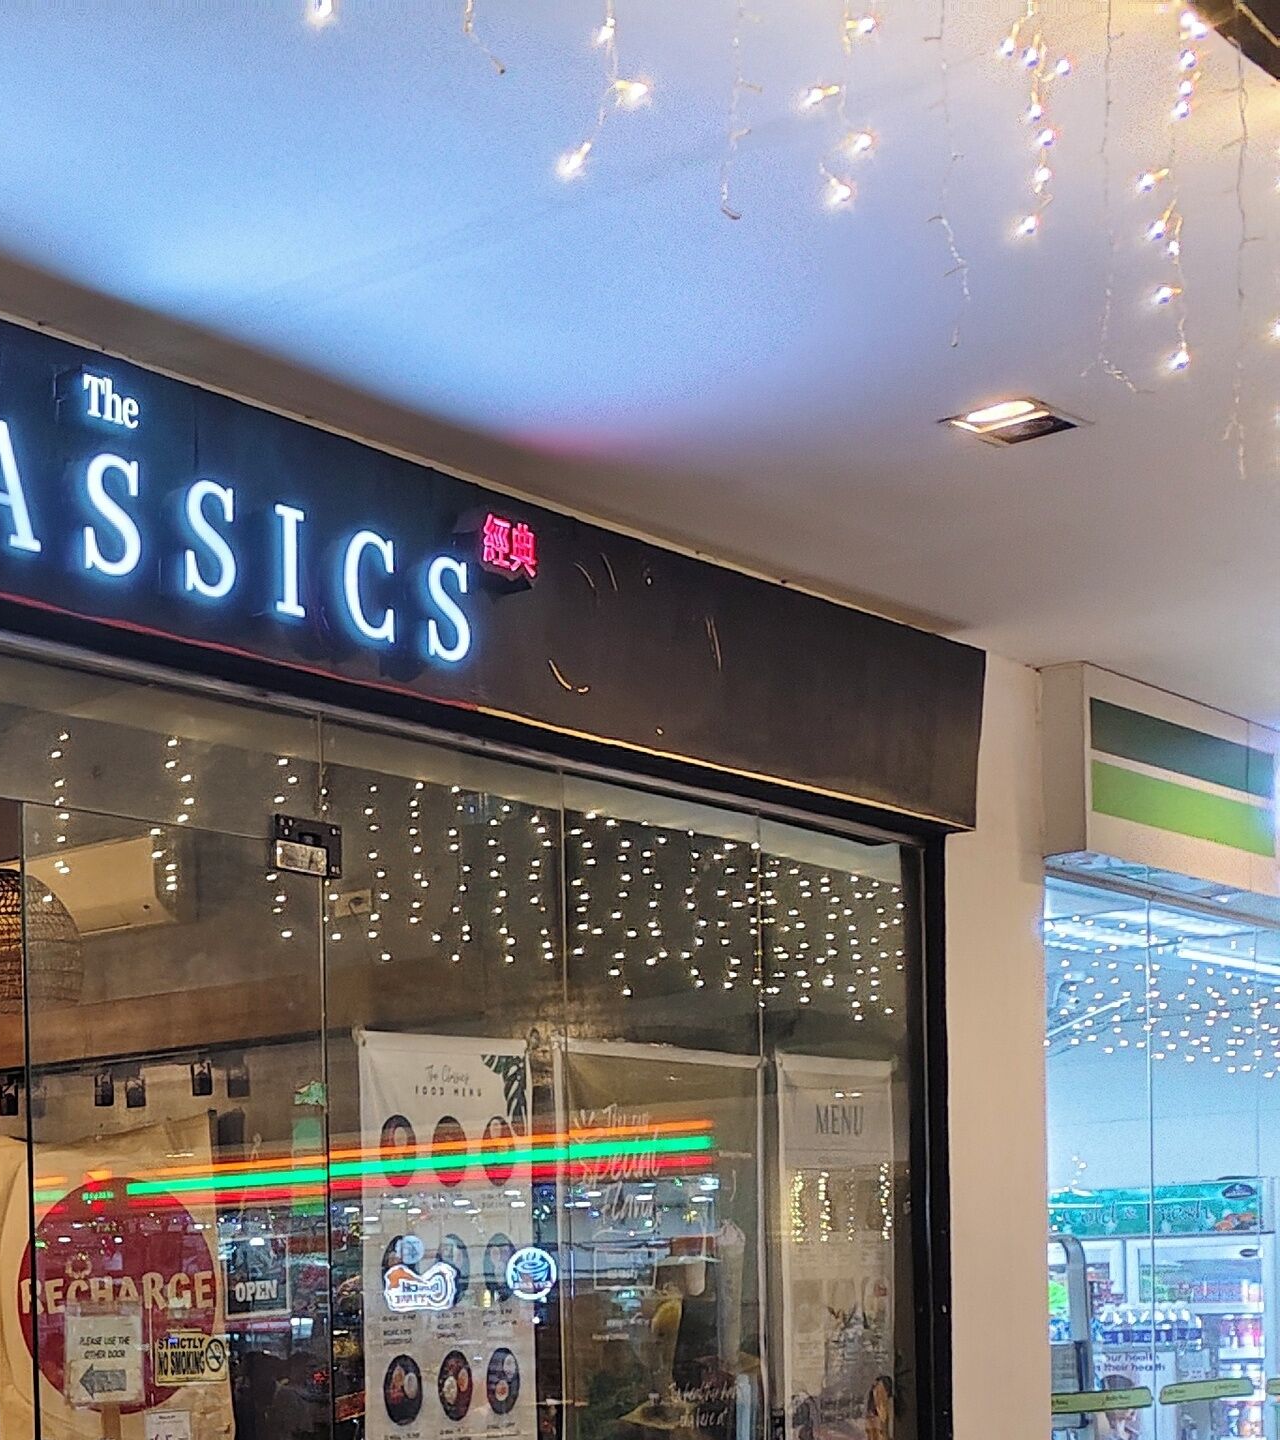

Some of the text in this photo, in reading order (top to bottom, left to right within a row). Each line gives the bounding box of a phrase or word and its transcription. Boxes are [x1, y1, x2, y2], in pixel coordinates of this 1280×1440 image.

[83, 373, 139, 429] The
[483, 513, 537, 577] 經典
[815, 1104, 864, 1136] MENU
[20, 1270, 215, 1314] RECHARGE
[234, 1279, 277, 1303] OPEN
[79, 1335, 131, 1346] PLEASE USE THE
[158, 1337, 206, 1350] STRICTLY
[84, 1350, 126, 1359] OTHER DOOR
[158, 1350, 206, 1376] NO SMOKING
